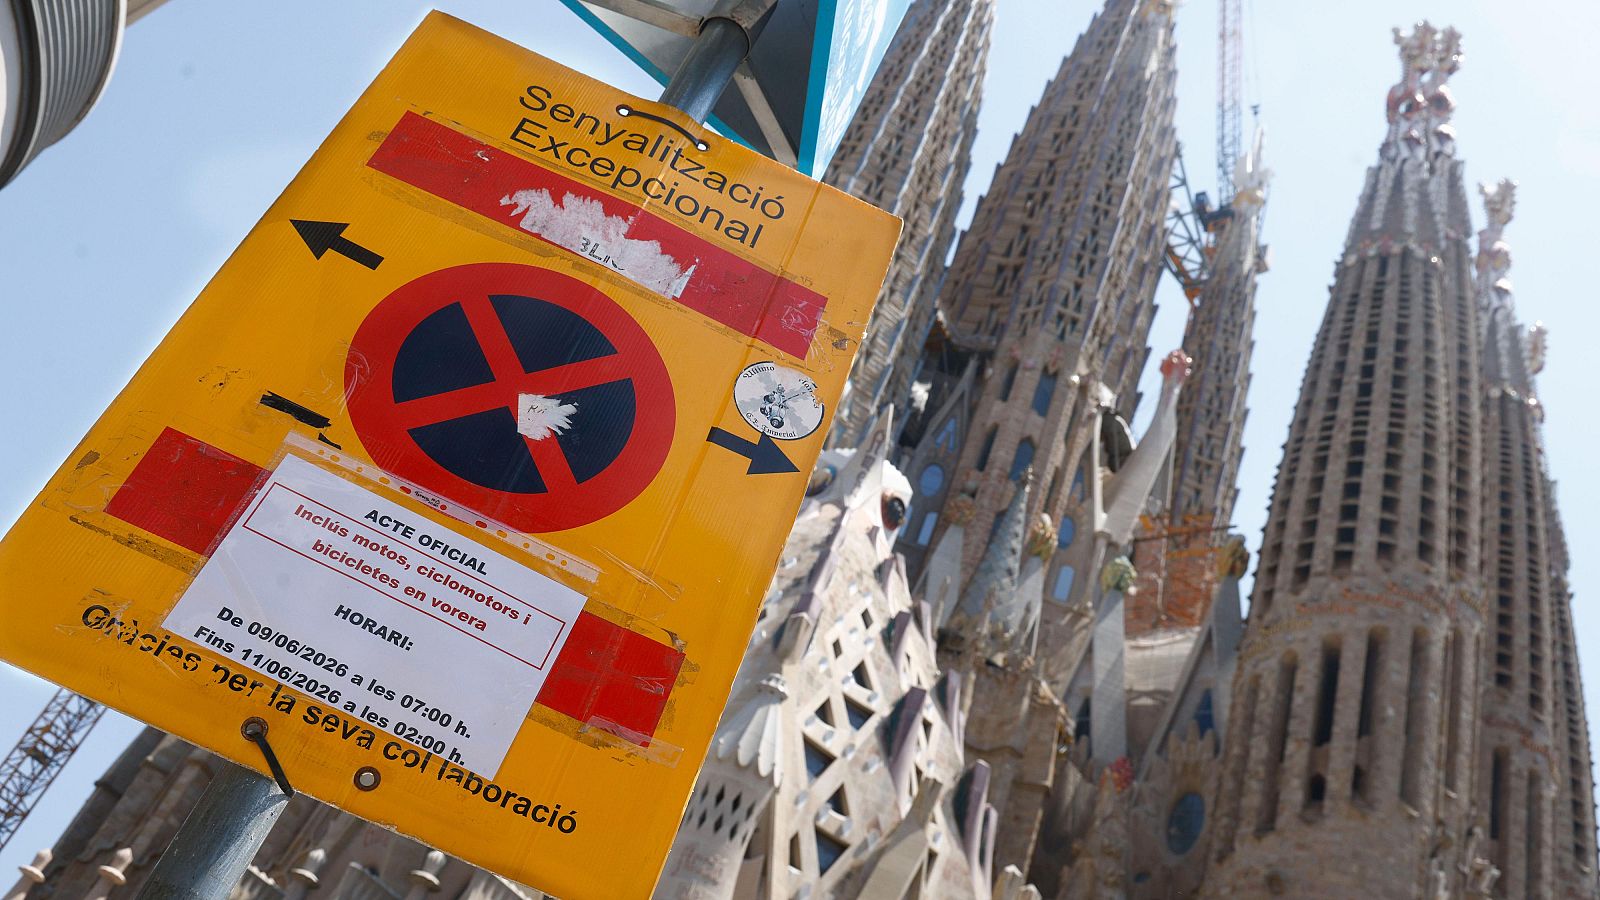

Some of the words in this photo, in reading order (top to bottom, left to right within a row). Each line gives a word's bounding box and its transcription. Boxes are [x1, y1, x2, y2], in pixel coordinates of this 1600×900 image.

[509, 117, 763, 248] Excepcional
[519, 85, 785, 220] Senyalització
[294, 504, 349, 538] Inclús
[352, 531, 411, 571] motos,
[416, 562, 520, 618] ciclomotors
[523, 612, 532, 626] i
[311, 539, 399, 590] bicicletes
[403, 583, 427, 602] en
[431, 596, 488, 632] vorera
[364, 509, 416, 539] ACTE
[418, 533, 487, 575] OFICIAL
[217, 606, 244, 630] De
[247, 620, 349, 678] 09/06/2026
[351, 673, 364, 688] a
[366, 677, 396, 702] les
[400, 694, 452, 729] 07:00
[455, 720, 471, 738] h.
[333, 604, 414, 651] HORARI:
[194, 625, 235, 654] Fins
[240, 647, 342, 704] 11/06/2026
[343, 699, 357, 713] a
[360, 703, 389, 728] les
[393, 722, 446, 757] 02:00
[448, 747, 465, 765] h.
[268, 683, 297, 715] la
[302, 705, 376, 751] seva
